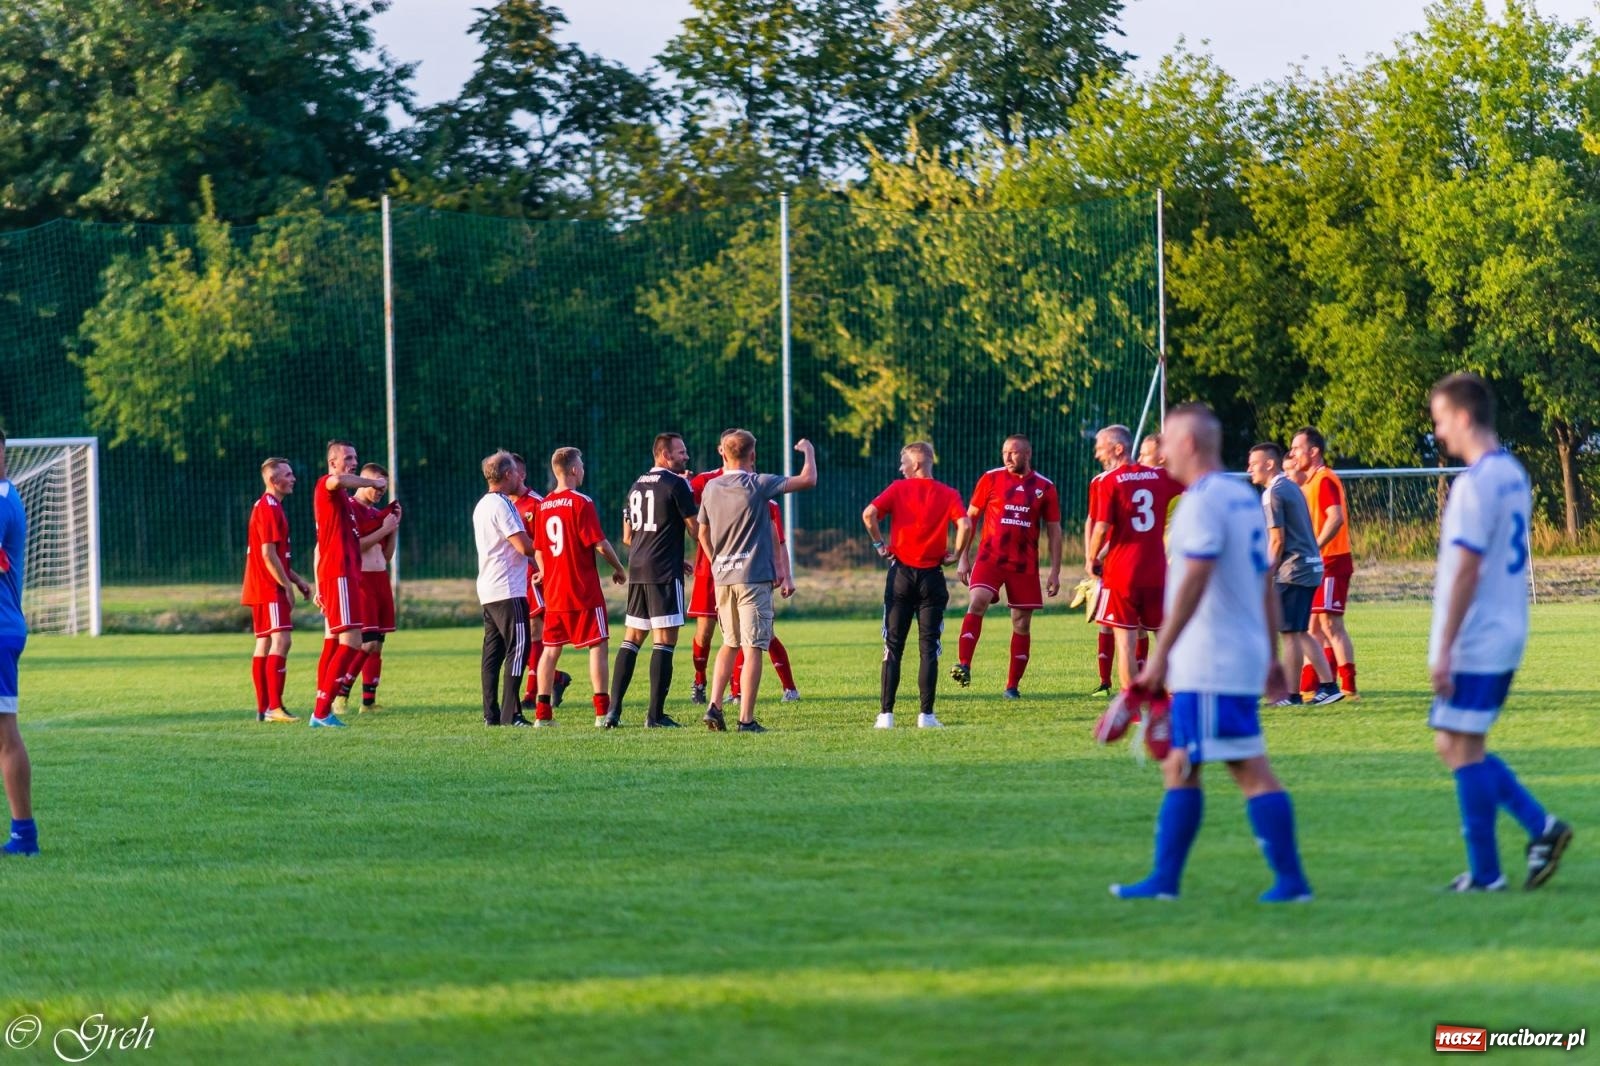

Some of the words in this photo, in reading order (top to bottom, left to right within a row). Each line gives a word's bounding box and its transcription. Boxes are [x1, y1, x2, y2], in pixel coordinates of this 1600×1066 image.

[629, 489, 659, 532] 81
[1131, 488, 1156, 533] 3
[545, 515, 564, 557] 9
[1507, 511, 1526, 575] 3
